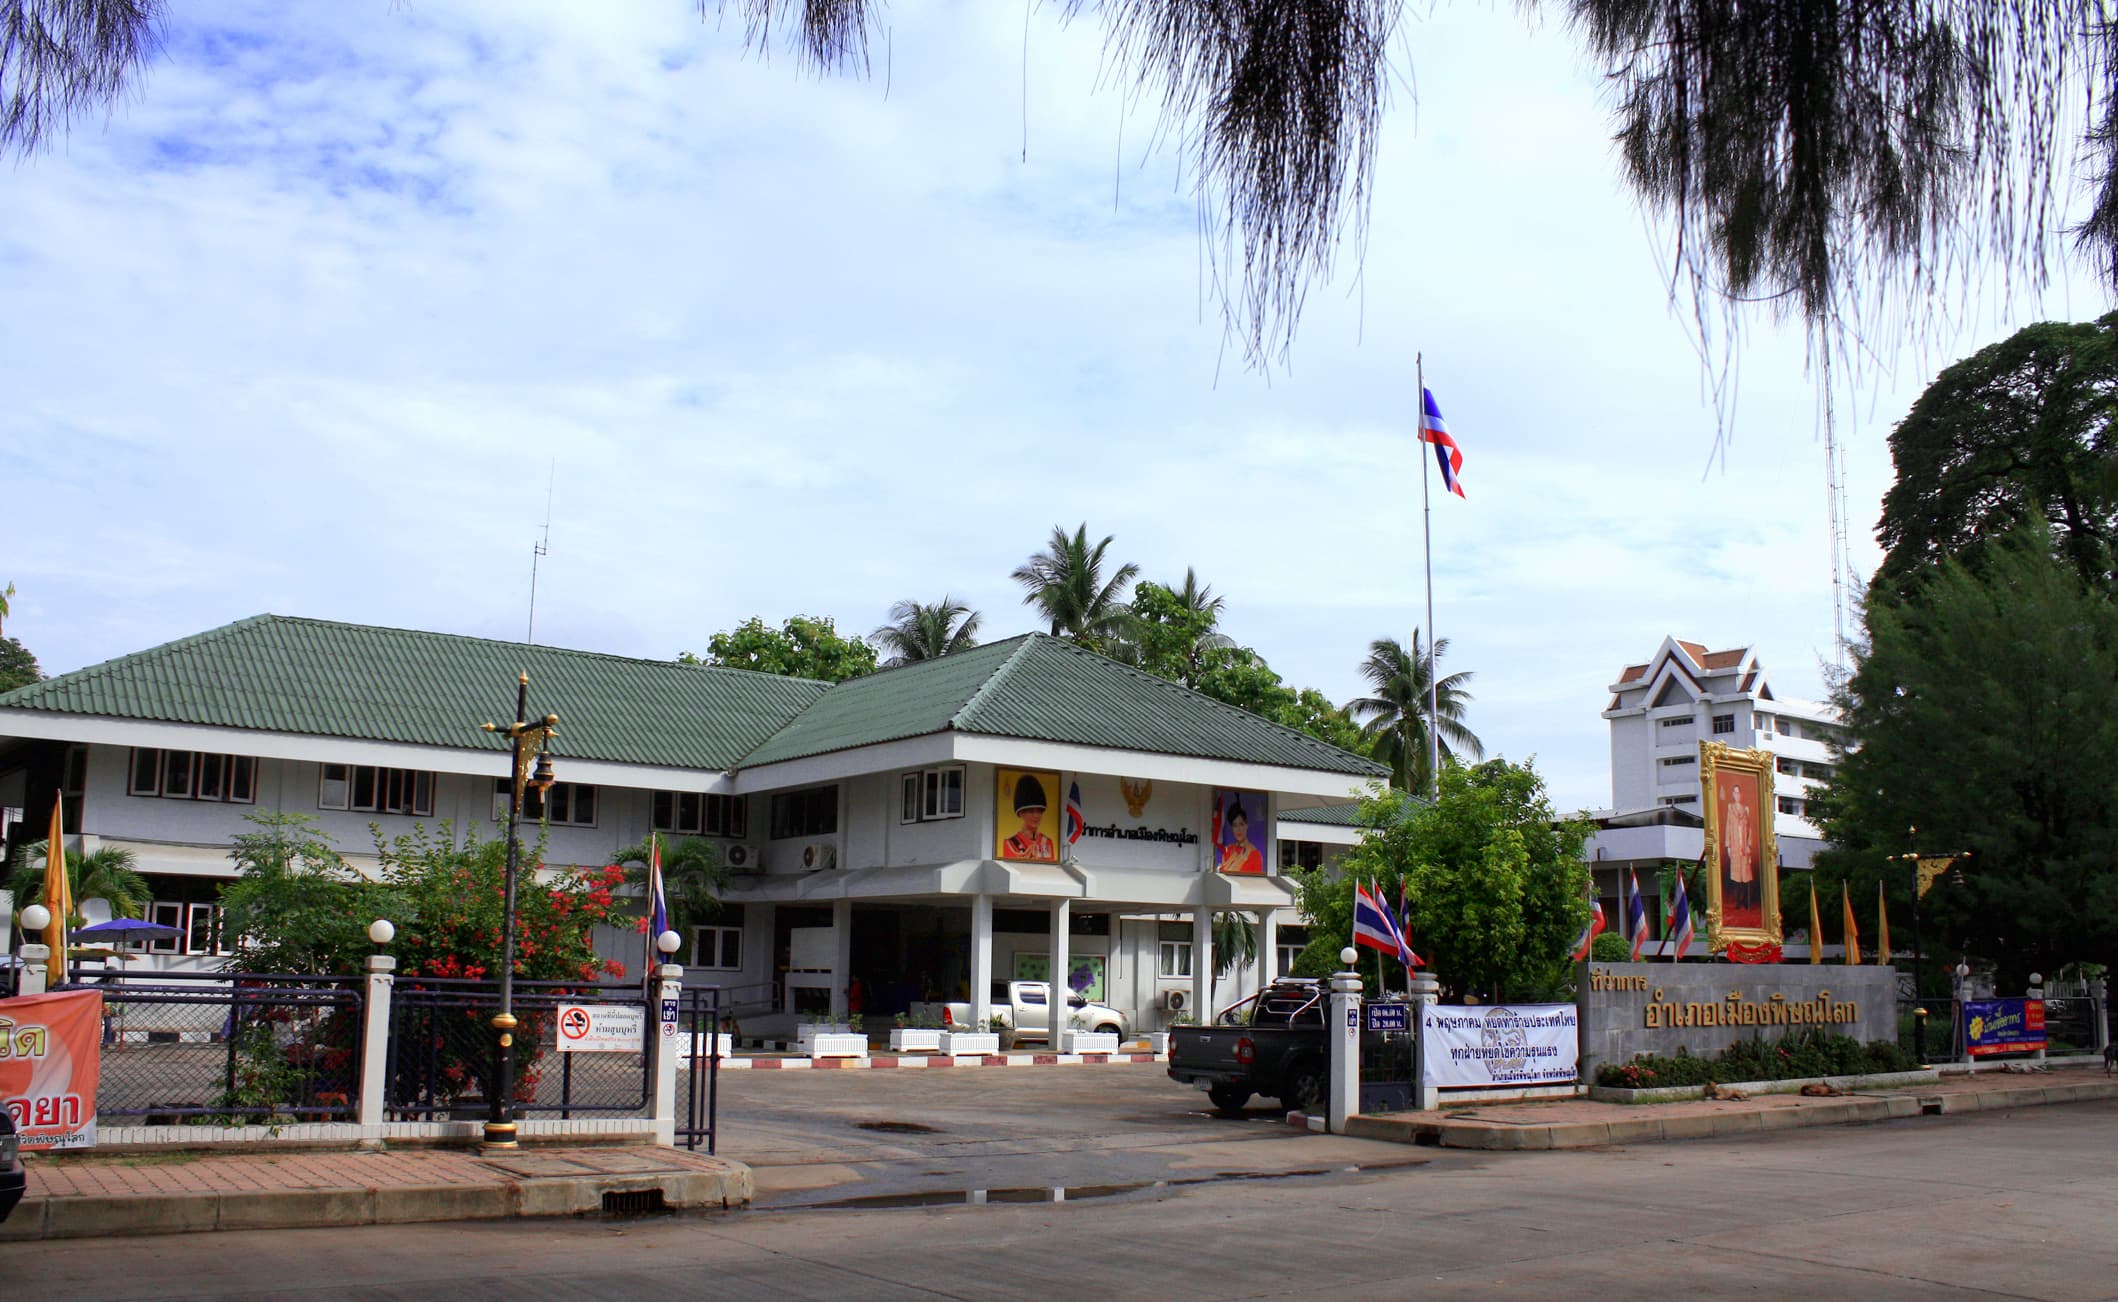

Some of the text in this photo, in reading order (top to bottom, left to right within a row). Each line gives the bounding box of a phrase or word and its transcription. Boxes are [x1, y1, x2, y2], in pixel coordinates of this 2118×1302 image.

[1591, 968, 1648, 992] ที่ว่าการ
[1645, 988, 1858, 1029] อำเภอเมืองพิษณุโลก
[1425, 1018, 1433, 1028] 4
[1436, 1016, 1482, 1033] พฤษภาคม
